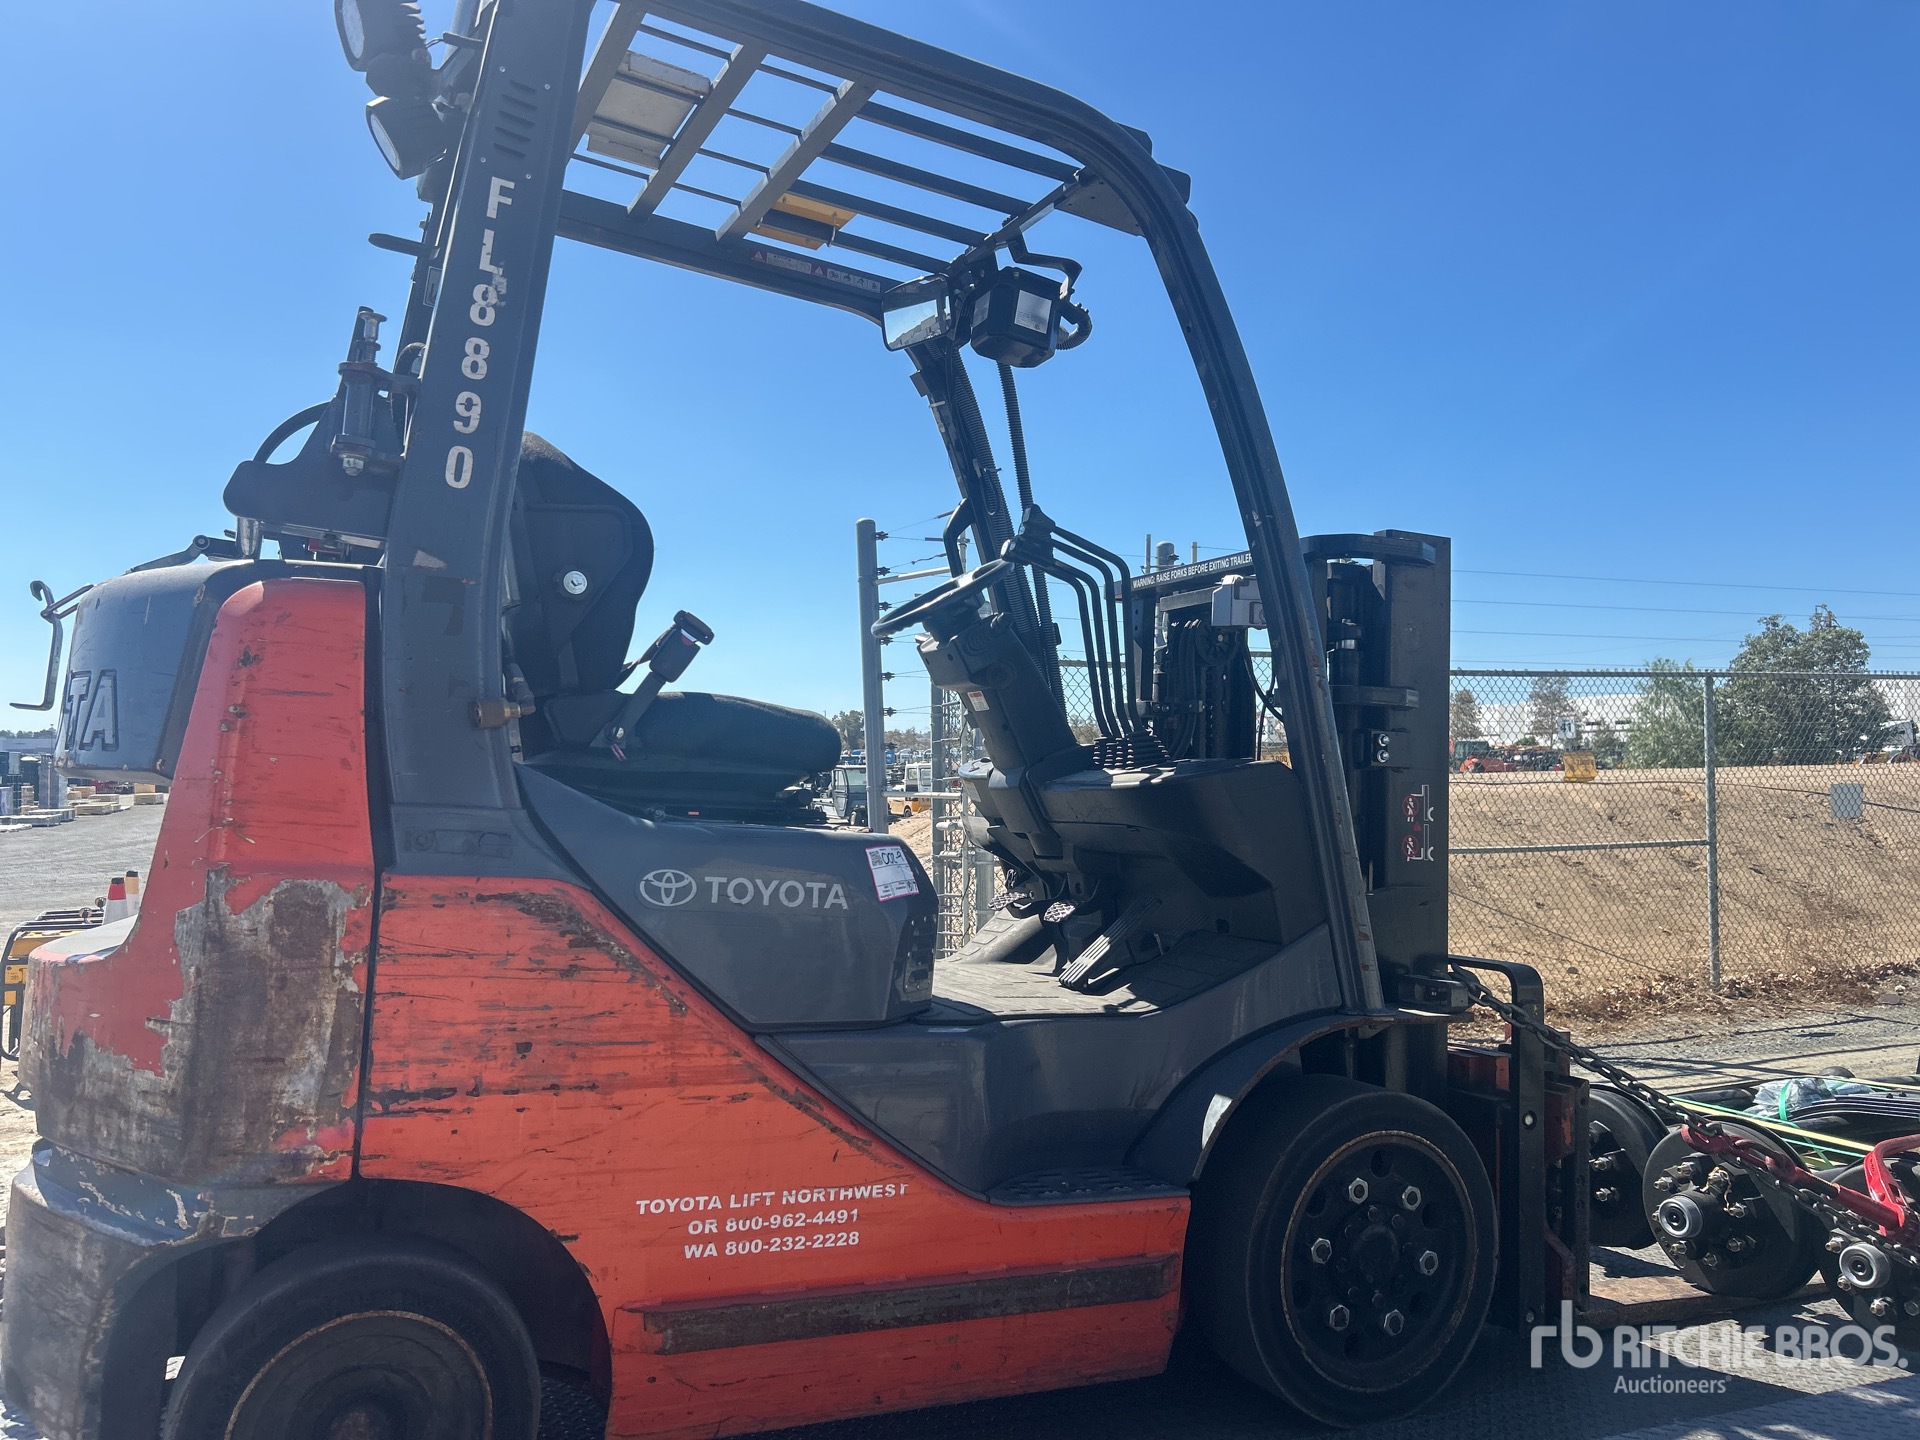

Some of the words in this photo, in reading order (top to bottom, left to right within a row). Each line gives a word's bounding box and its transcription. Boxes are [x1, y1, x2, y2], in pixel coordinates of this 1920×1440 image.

[1132, 575, 1156, 589] WARNING:
[1156, 572, 1170, 583] RAISE
[1170, 568, 1188, 580] FORKS
[1188, 563, 1208, 576] BEFORE
[1208, 559, 1230, 571] EXITING
[705, 876, 849, 910] TOYOTA
[636, 1195, 722, 1215] TOYOTA
[729, 1191, 775, 1209] LIFT
[782, 1183, 909, 1205] NORTHWEST
[688, 1219, 718, 1235] OR
[725, 1208, 859, 1233] 800-962-4491
[684, 1242, 718, 1259] WA
[725, 1231, 860, 1256] 800-232-2228
